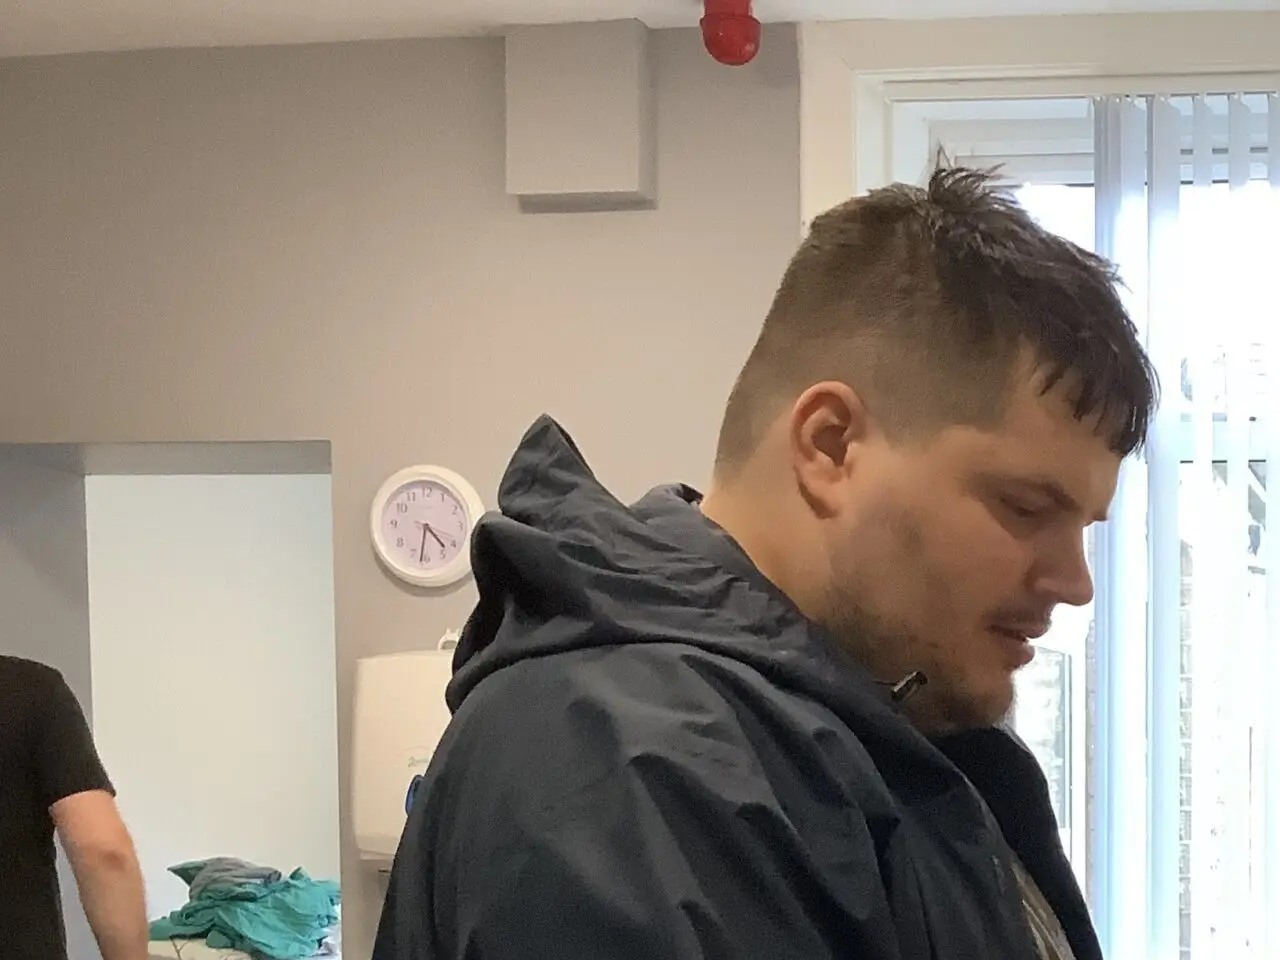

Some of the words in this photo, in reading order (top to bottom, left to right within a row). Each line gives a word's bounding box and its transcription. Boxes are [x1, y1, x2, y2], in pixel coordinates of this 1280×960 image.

[407, 492, 416, 502] 11
[421, 486, 433, 498] 12
[441, 493, 446, 503] 1
[396, 503, 408, 514] 10
[451, 504, 458, 515] 2
[389, 519, 398, 529] 9
[396, 537, 405, 548] 8
[450, 540, 457, 549] 4
[410, 548, 417, 559] 7
[439, 548, 446, 560] 5
